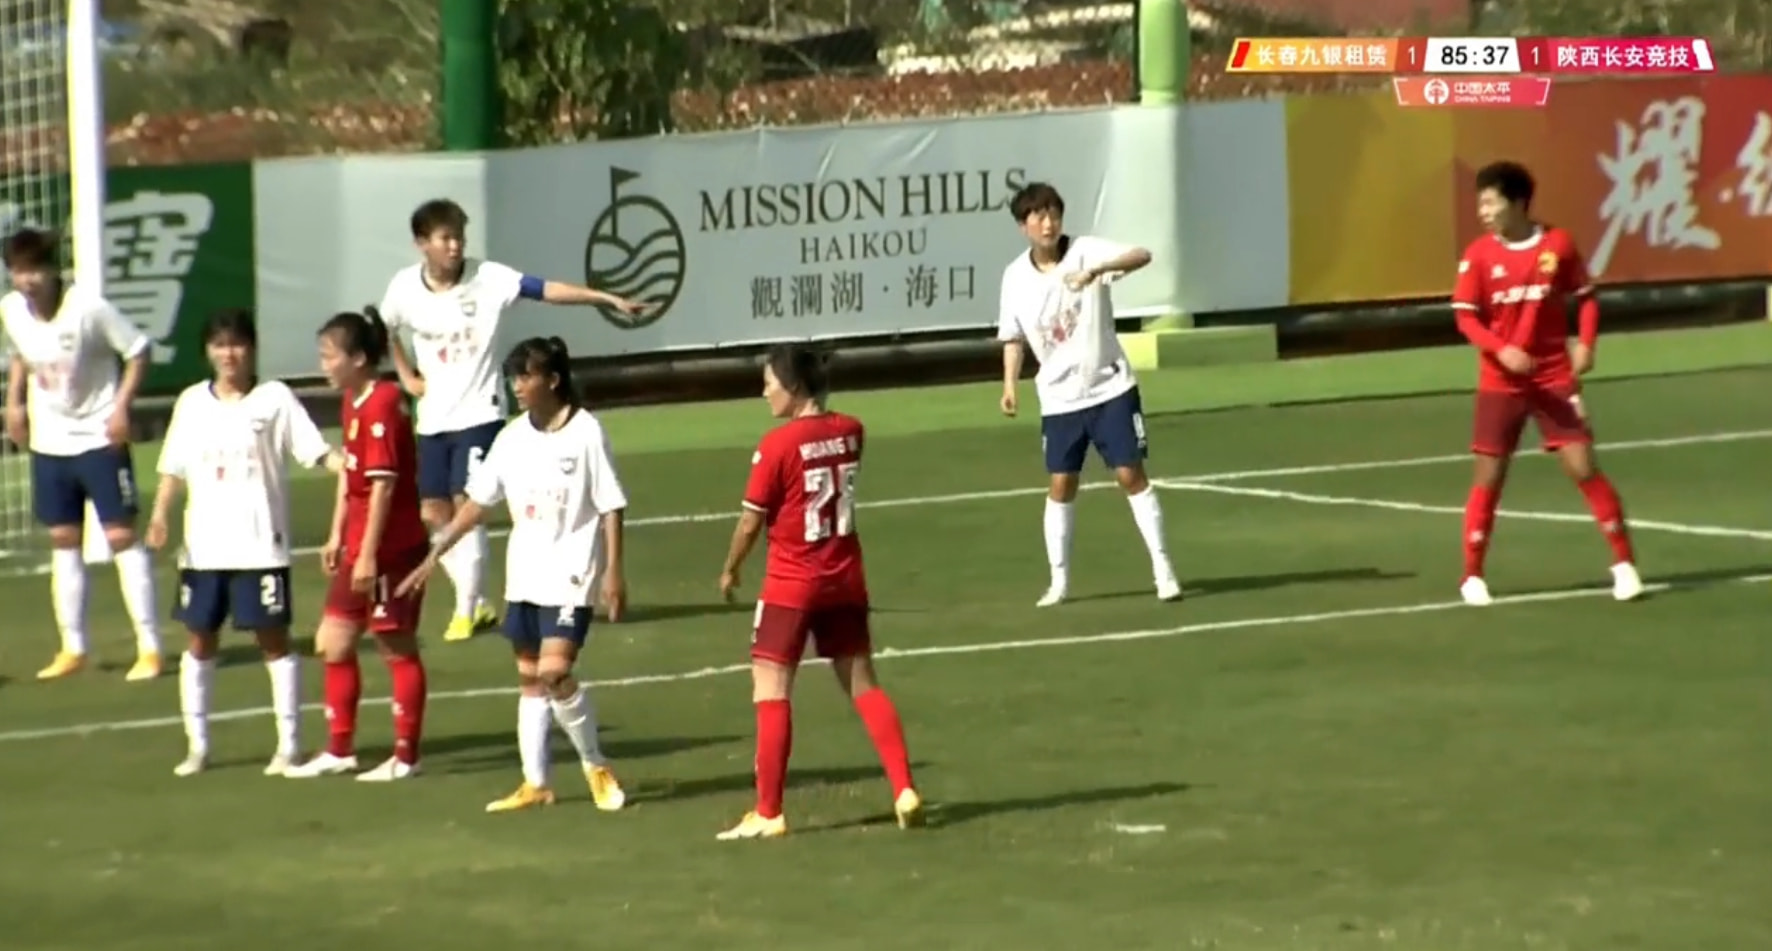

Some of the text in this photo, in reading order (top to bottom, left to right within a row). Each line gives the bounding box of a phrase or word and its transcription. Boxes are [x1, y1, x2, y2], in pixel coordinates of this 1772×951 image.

[699, 167, 1026, 232] MISSION HILLS
[799, 227, 929, 265] HAIKOU
